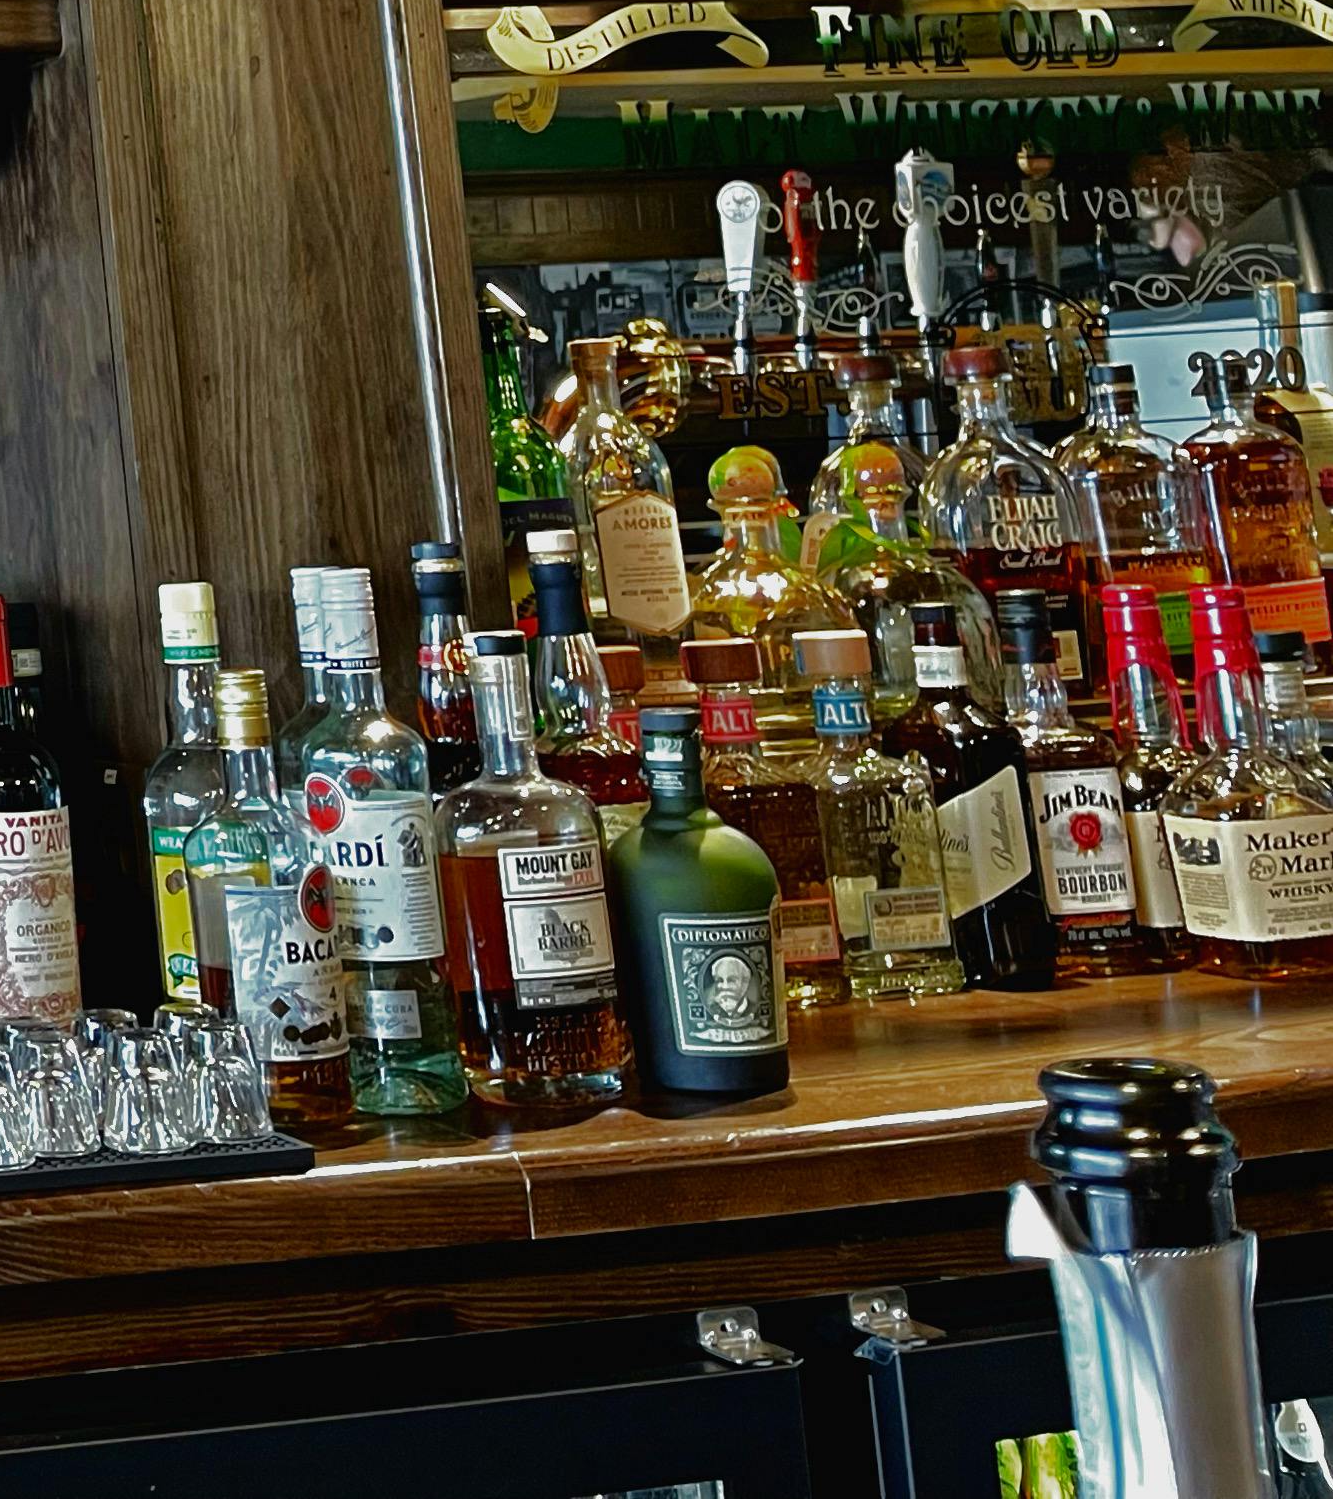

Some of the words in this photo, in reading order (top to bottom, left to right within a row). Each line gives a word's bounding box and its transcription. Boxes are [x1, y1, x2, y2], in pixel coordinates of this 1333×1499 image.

[546, 2, 706, 71] DISTILLED
[811, 5, 970, 77] FINE
[999, 4, 1120, 71] OLD
[812, 186, 880, 231] the
[1082, 178, 1225, 226] variety
[1188, 346, 1305, 398] 220
[716, 370, 852, 420] EST.
[987, 495, 1059, 523] ELIJAH
[613, 516, 672, 531] AMORES
[991, 522, 1062, 551] CRAIG
[340, 660, 364, 668] WHITE
[1039, 793, 1072, 824] JIM
[1074, 784, 1120, 819] BEAM
[31, 826, 70, 854] D'AVO
[1245, 829, 1333, 852] Maker'
[515, 854, 567, 876] MOUNT
[571, 852, 594, 870] GAY
[1280, 851, 1333, 873] Mar
[334, 878, 376, 887] LANCA
[1058, 873, 1127, 895] BOURBON
[1268, 884, 1333, 899] WHISKY
[17, 920, 71, 938] ORGANICO
[541, 919, 589, 937] BLACK
[286, 939, 335, 964] BACA
[538, 932, 596, 951] BARREL
[15, 952, 41, 963] NERO
[384, 1004, 413, 1014] CUBA
